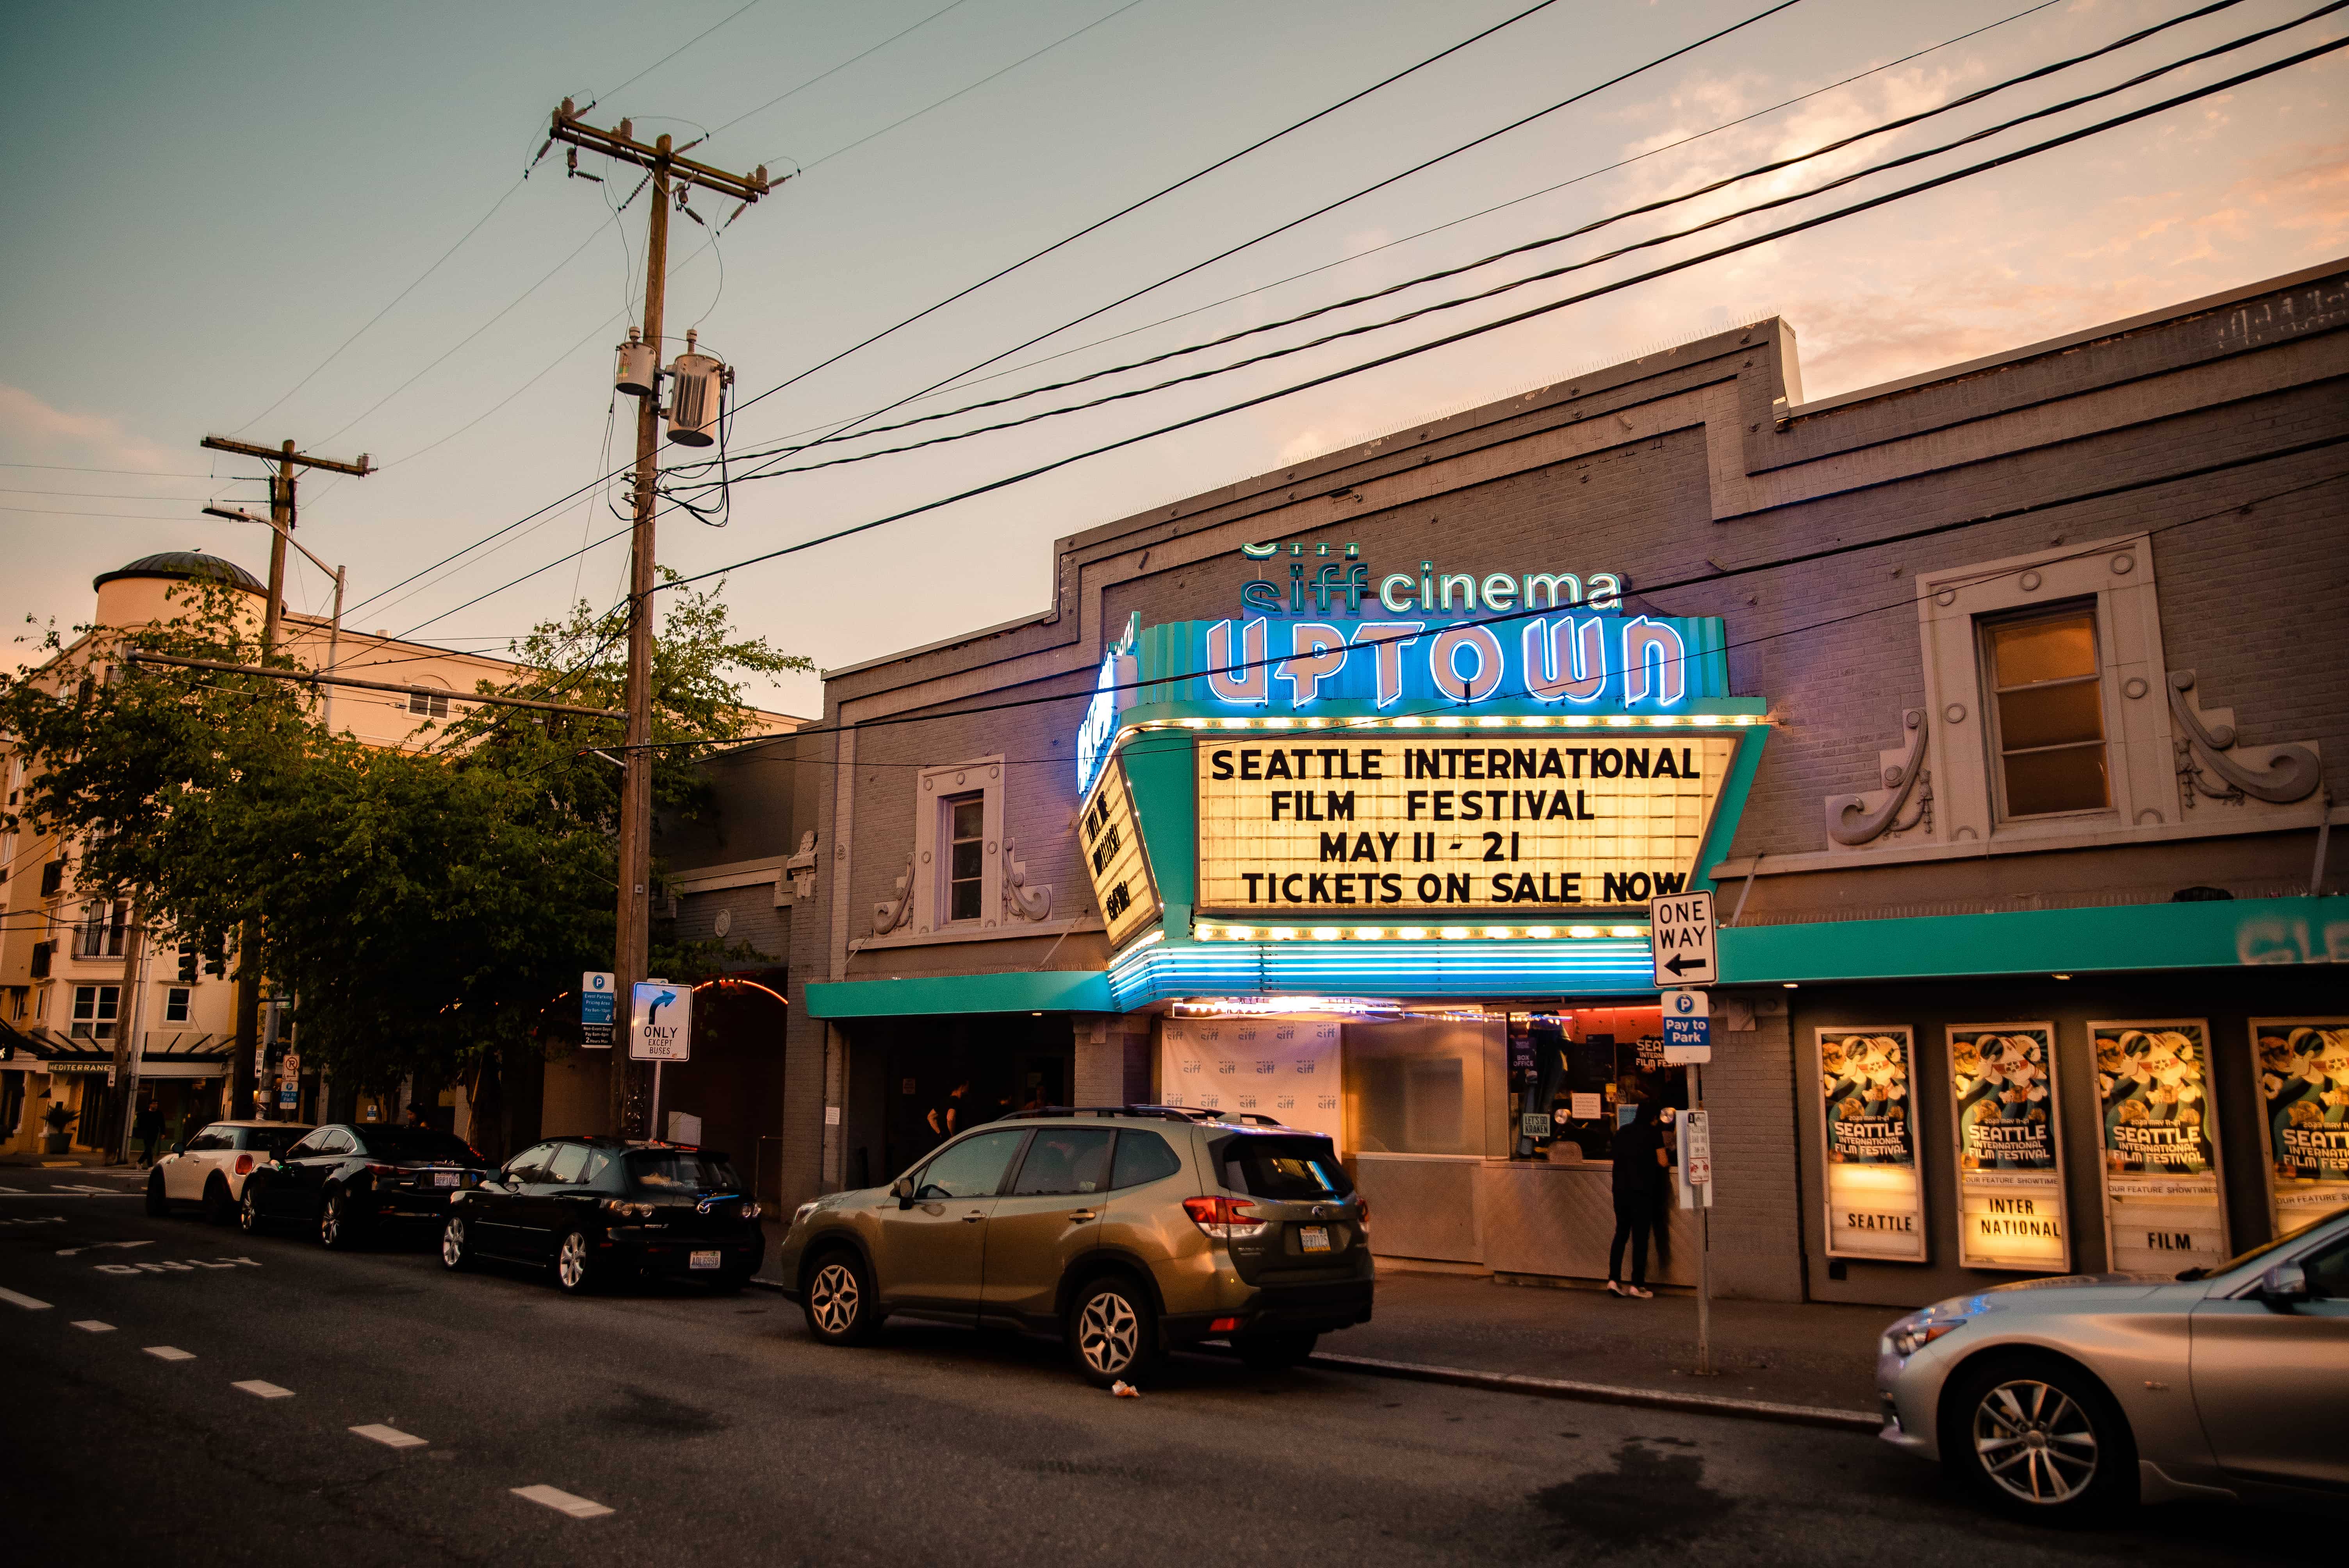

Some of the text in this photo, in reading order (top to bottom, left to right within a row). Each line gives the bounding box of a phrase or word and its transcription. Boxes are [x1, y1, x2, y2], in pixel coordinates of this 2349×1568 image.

[1241, 561, 1623, 615] siff cinema
[1207, 616, 1685, 707] UPTOWN
[1212, 748, 1700, 780] SEATTLE INTERNATIONAL
[1271, 790, 1594, 821] FILM FESTIVAL
[1320, 832, 1399, 862] MAY
[1413, 832, 1435, 862] 11
[1483, 832, 1519, 862] 21
[1242, 872, 1687, 903] TICKETS ON SALE NOW
[1660, 900, 1705, 924] ONE
[1659, 926, 1706, 949] WAY
[644, 1026, 678, 1038] ONLY
[1666, 1019, 1707, 1032] Pay to
[649, 1039, 672, 1047] EXCEPT
[1672, 1032, 1701, 1043] Park
[1635, 1058, 1656, 1071] FILM
[1540, 1116, 1547, 1124] GO
[1525, 1125, 1548, 1133] KRAKEN
[1835, 1121, 1904, 1137] SEATTLE
[1969, 1124, 2047, 1141] SEATTLE
[2113, 1126, 2201, 1144] SEATTLE
[1835, 1143, 1907, 1156] FILM FESTIVAL
[1839, 1137, 1902, 1146] INTERNATIONAL
[1973, 1140, 2044, 1149] INTERNATIONAL
[2119, 1142, 2198, 1153] INTERNATIONAL
[1969, 1147, 2050, 1160] FILM FESTIVAL
[2114, 1150, 2205, 1165] FILM FESTIVAL
[2289, 1146, 2349, 1159] INTERNATI
[2283, 1155, 2317, 1169] FILM
[1989, 1198, 2034, 1214] INTER
[1848, 1213, 1911, 1231] SEATTLE
[1981, 1219, 2061, 1237] NATIONAL
[2148, 1233, 2190, 1249] FILM
[94, 1257, 262, 1274] ONLY
